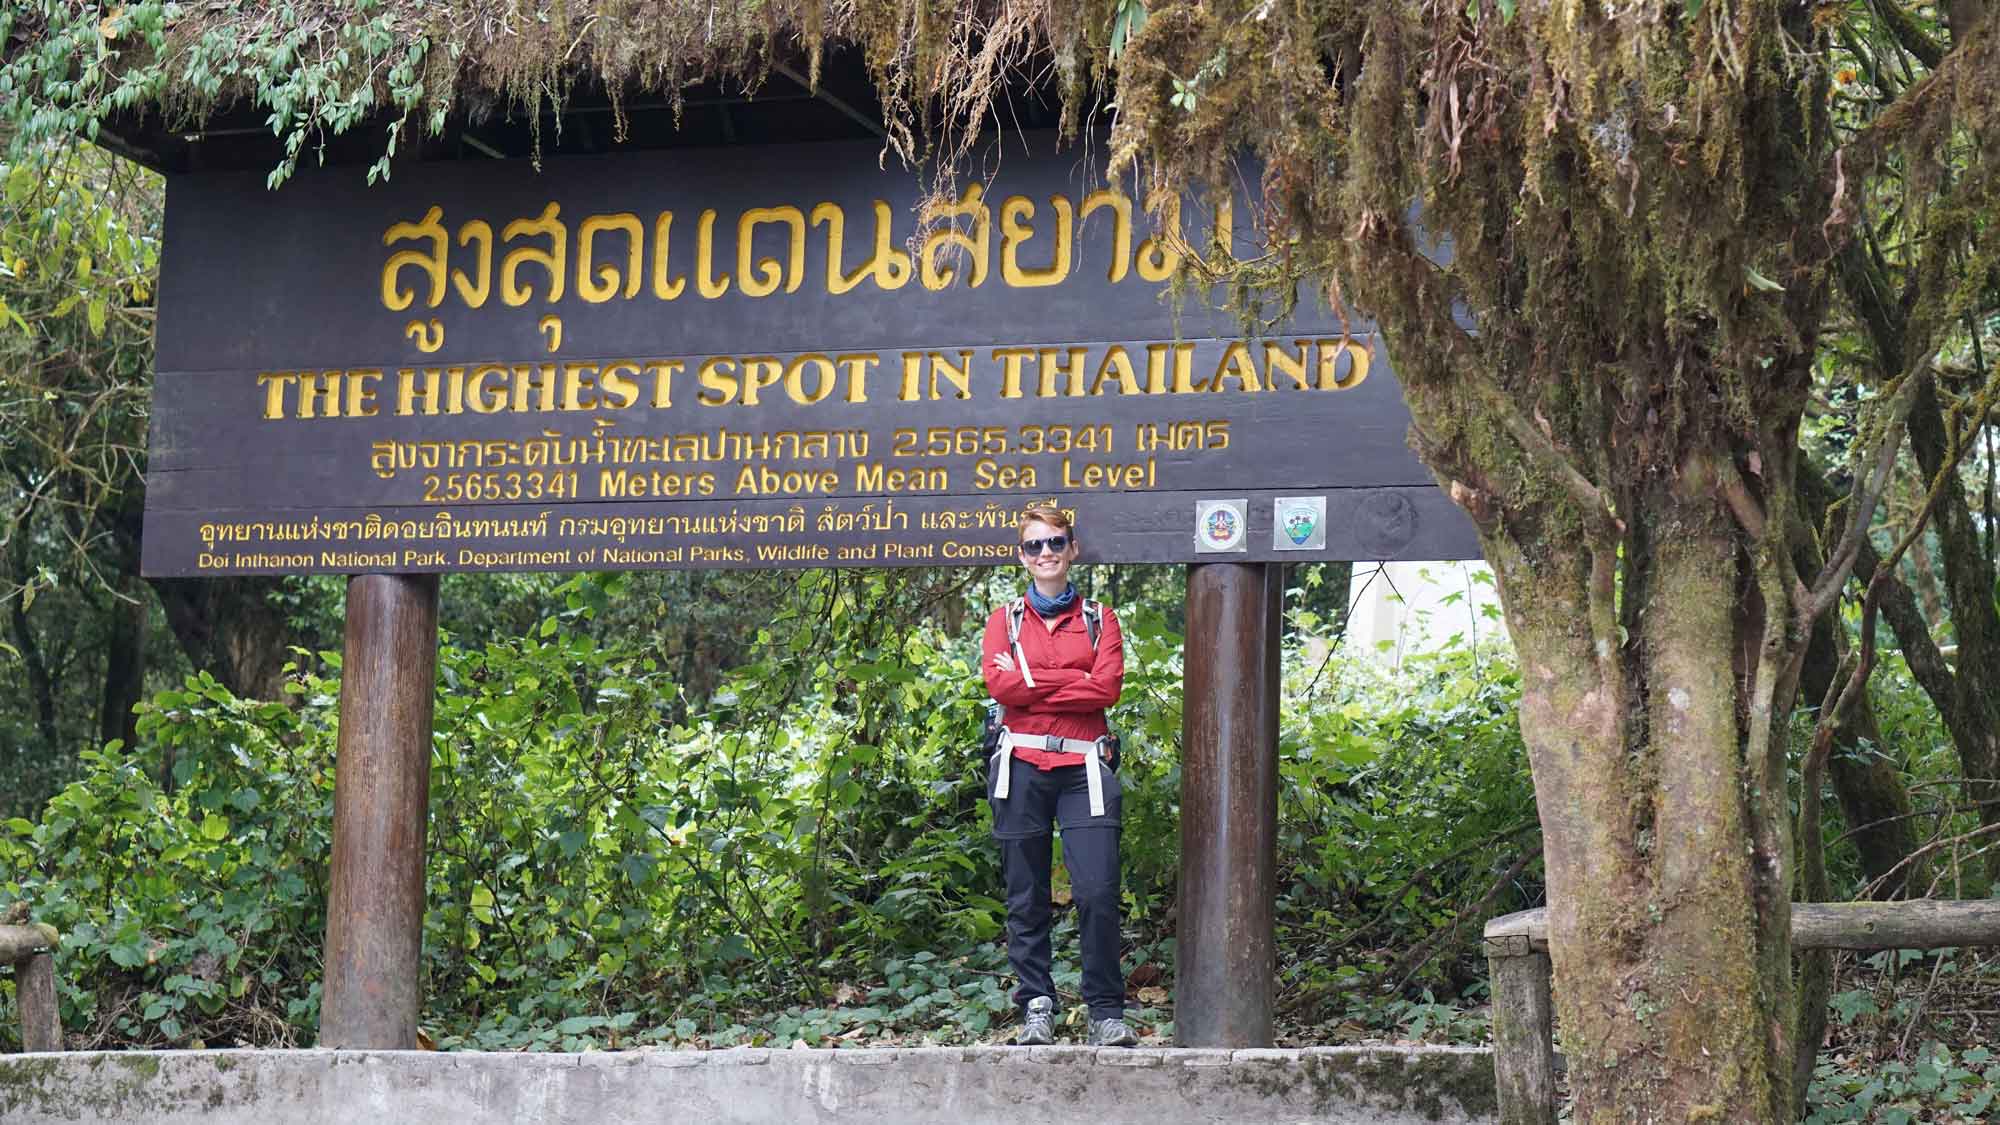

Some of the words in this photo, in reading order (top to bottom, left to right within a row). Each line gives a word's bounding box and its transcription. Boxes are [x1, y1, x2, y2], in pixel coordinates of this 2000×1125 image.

[257, 369, 383, 420] THE
[397, 361, 685, 418] HIGHEST
[698, 353, 881, 408] SPOT
[900, 350, 974, 401] IN
[991, 338, 1374, 399] THAILAND
[370, 417, 869, 479] สูงจากระดับน้ำทะเลปานกลาง
[893, 424, 1113, 457] 2.565.3341
[1136, 420, 1230, 452] เมตร
[600, 469, 716, 497] Meters
[736, 464, 839, 494] Above
[855, 462, 949, 492] Mean
[975, 459, 1037, 489] Sea
[1062, 458, 1156, 488] Level
[199, 511, 552, 550] อุทยานแห่งชาติดอยอินทนนท์
[559, 506, 805, 543] กรมอุทยานแห่งชาติ
[817, 498, 909, 531] สัตว์ป่า
[199, 552, 229, 569] Doi
[235, 552, 314, 568] Inthanon
[321, 550, 396, 567] National
[458, 548, 570, 568] Department
[577, 547, 596, 562] of
[603, 547, 682, 563] National
[757, 543, 829, 561] Wildlife
[838, 543, 876, 560] and
[884, 542, 933, 558] Plant
